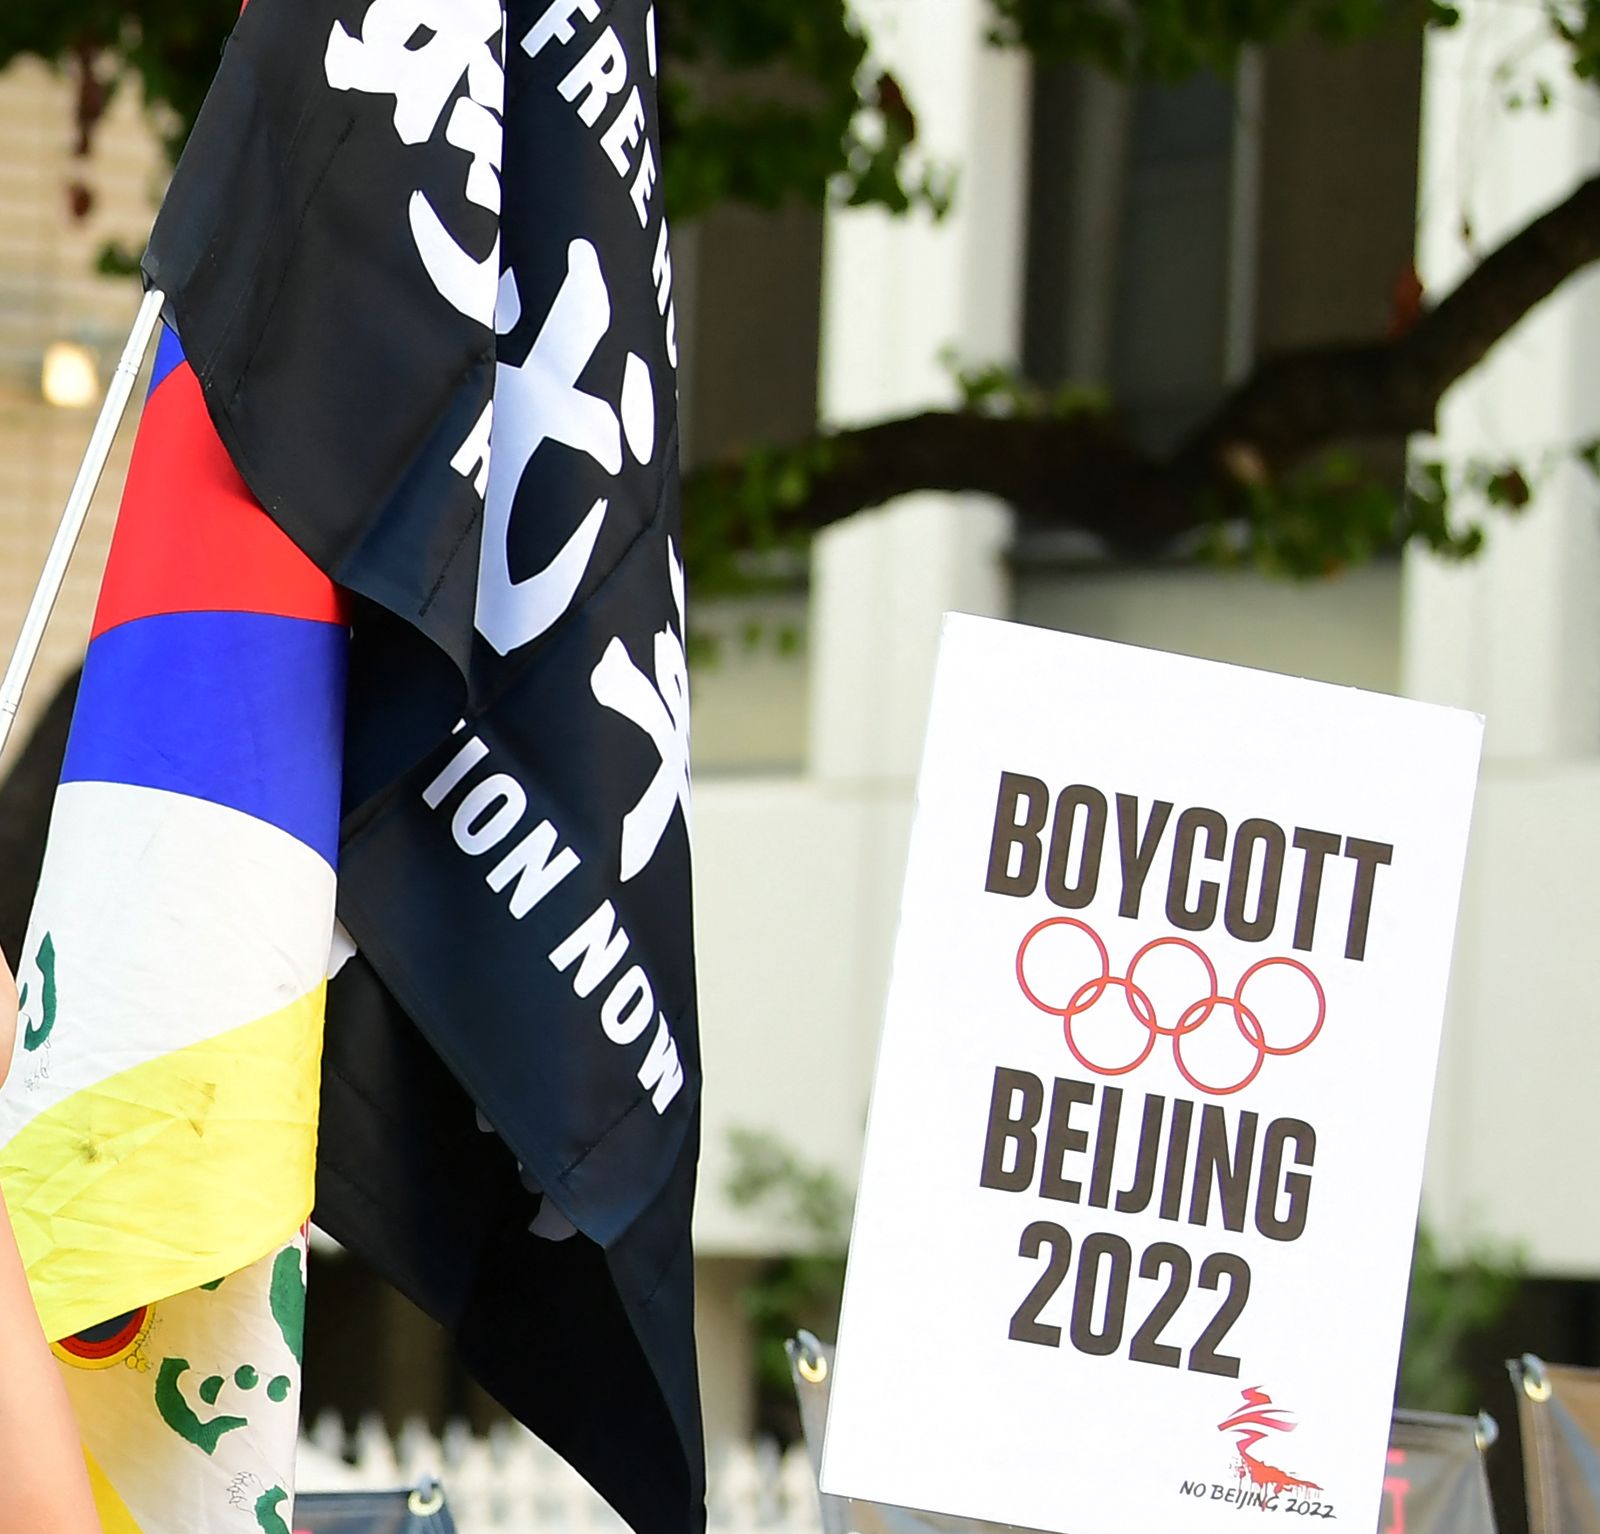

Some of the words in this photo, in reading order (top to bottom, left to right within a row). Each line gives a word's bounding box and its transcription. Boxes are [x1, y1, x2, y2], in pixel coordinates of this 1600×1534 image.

[984, 771, 1394, 962] BOYCOTT
[547, 898, 686, 1116] NOW
[979, 1064, 1318, 1242] BEIJING
[1007, 1219, 1253, 1379] 2022
[1179, 1480, 1206, 1498] NO
[1210, 1484, 1279, 1512] BEIJING
[1285, 1498, 1337, 1519] 2022
